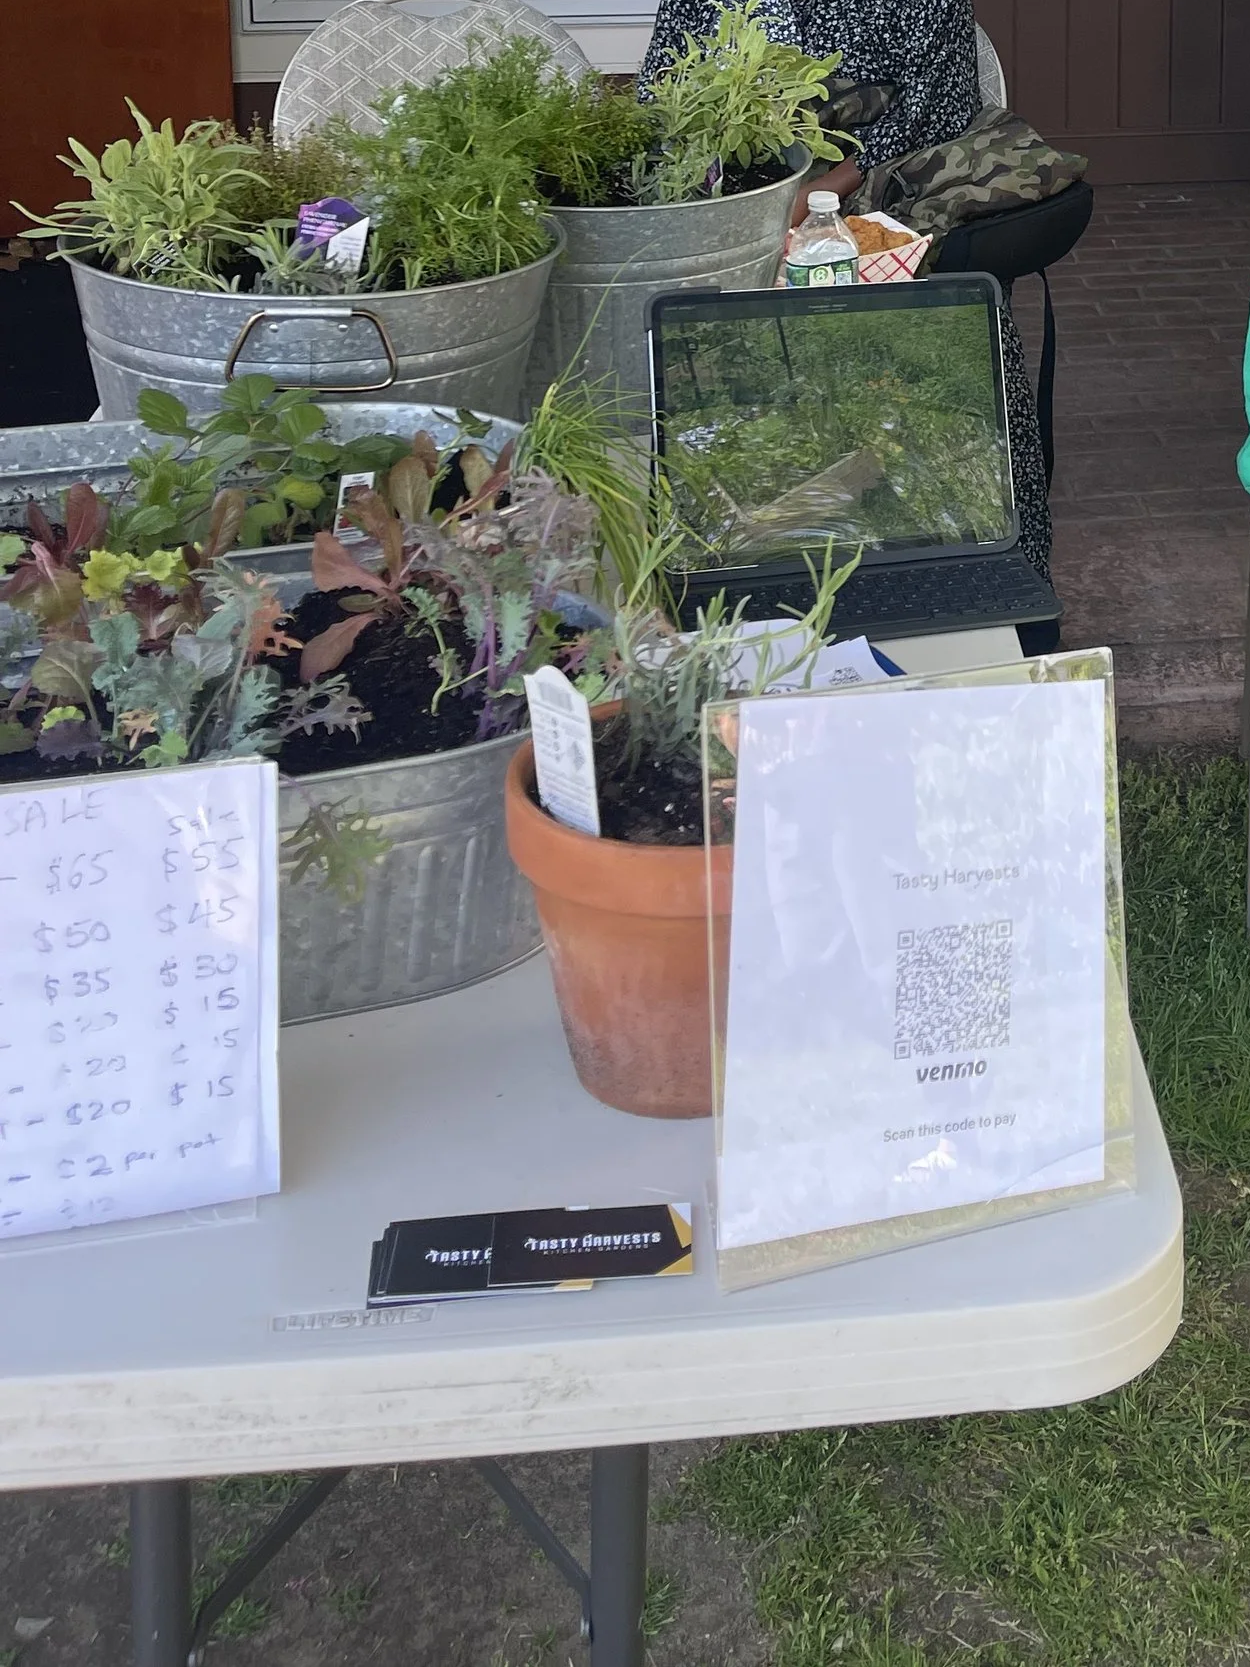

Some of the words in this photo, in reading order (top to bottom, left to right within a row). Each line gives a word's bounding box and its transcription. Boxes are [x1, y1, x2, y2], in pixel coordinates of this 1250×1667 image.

[893, 873, 939, 891] Tasty
[915, 1059, 988, 1084] venmo
[883, 1129, 915, 1143] Scan
[919, 1123, 942, 1137] this
[944, 1117, 976, 1133] code
[979, 1115, 992, 1128] to
[994, 1113, 1017, 1130] pay
[524, 1237, 578, 1251] TASTY
[582, 1233, 661, 1249] HARVESTS
[425, 1248, 481, 1263] TASTY
